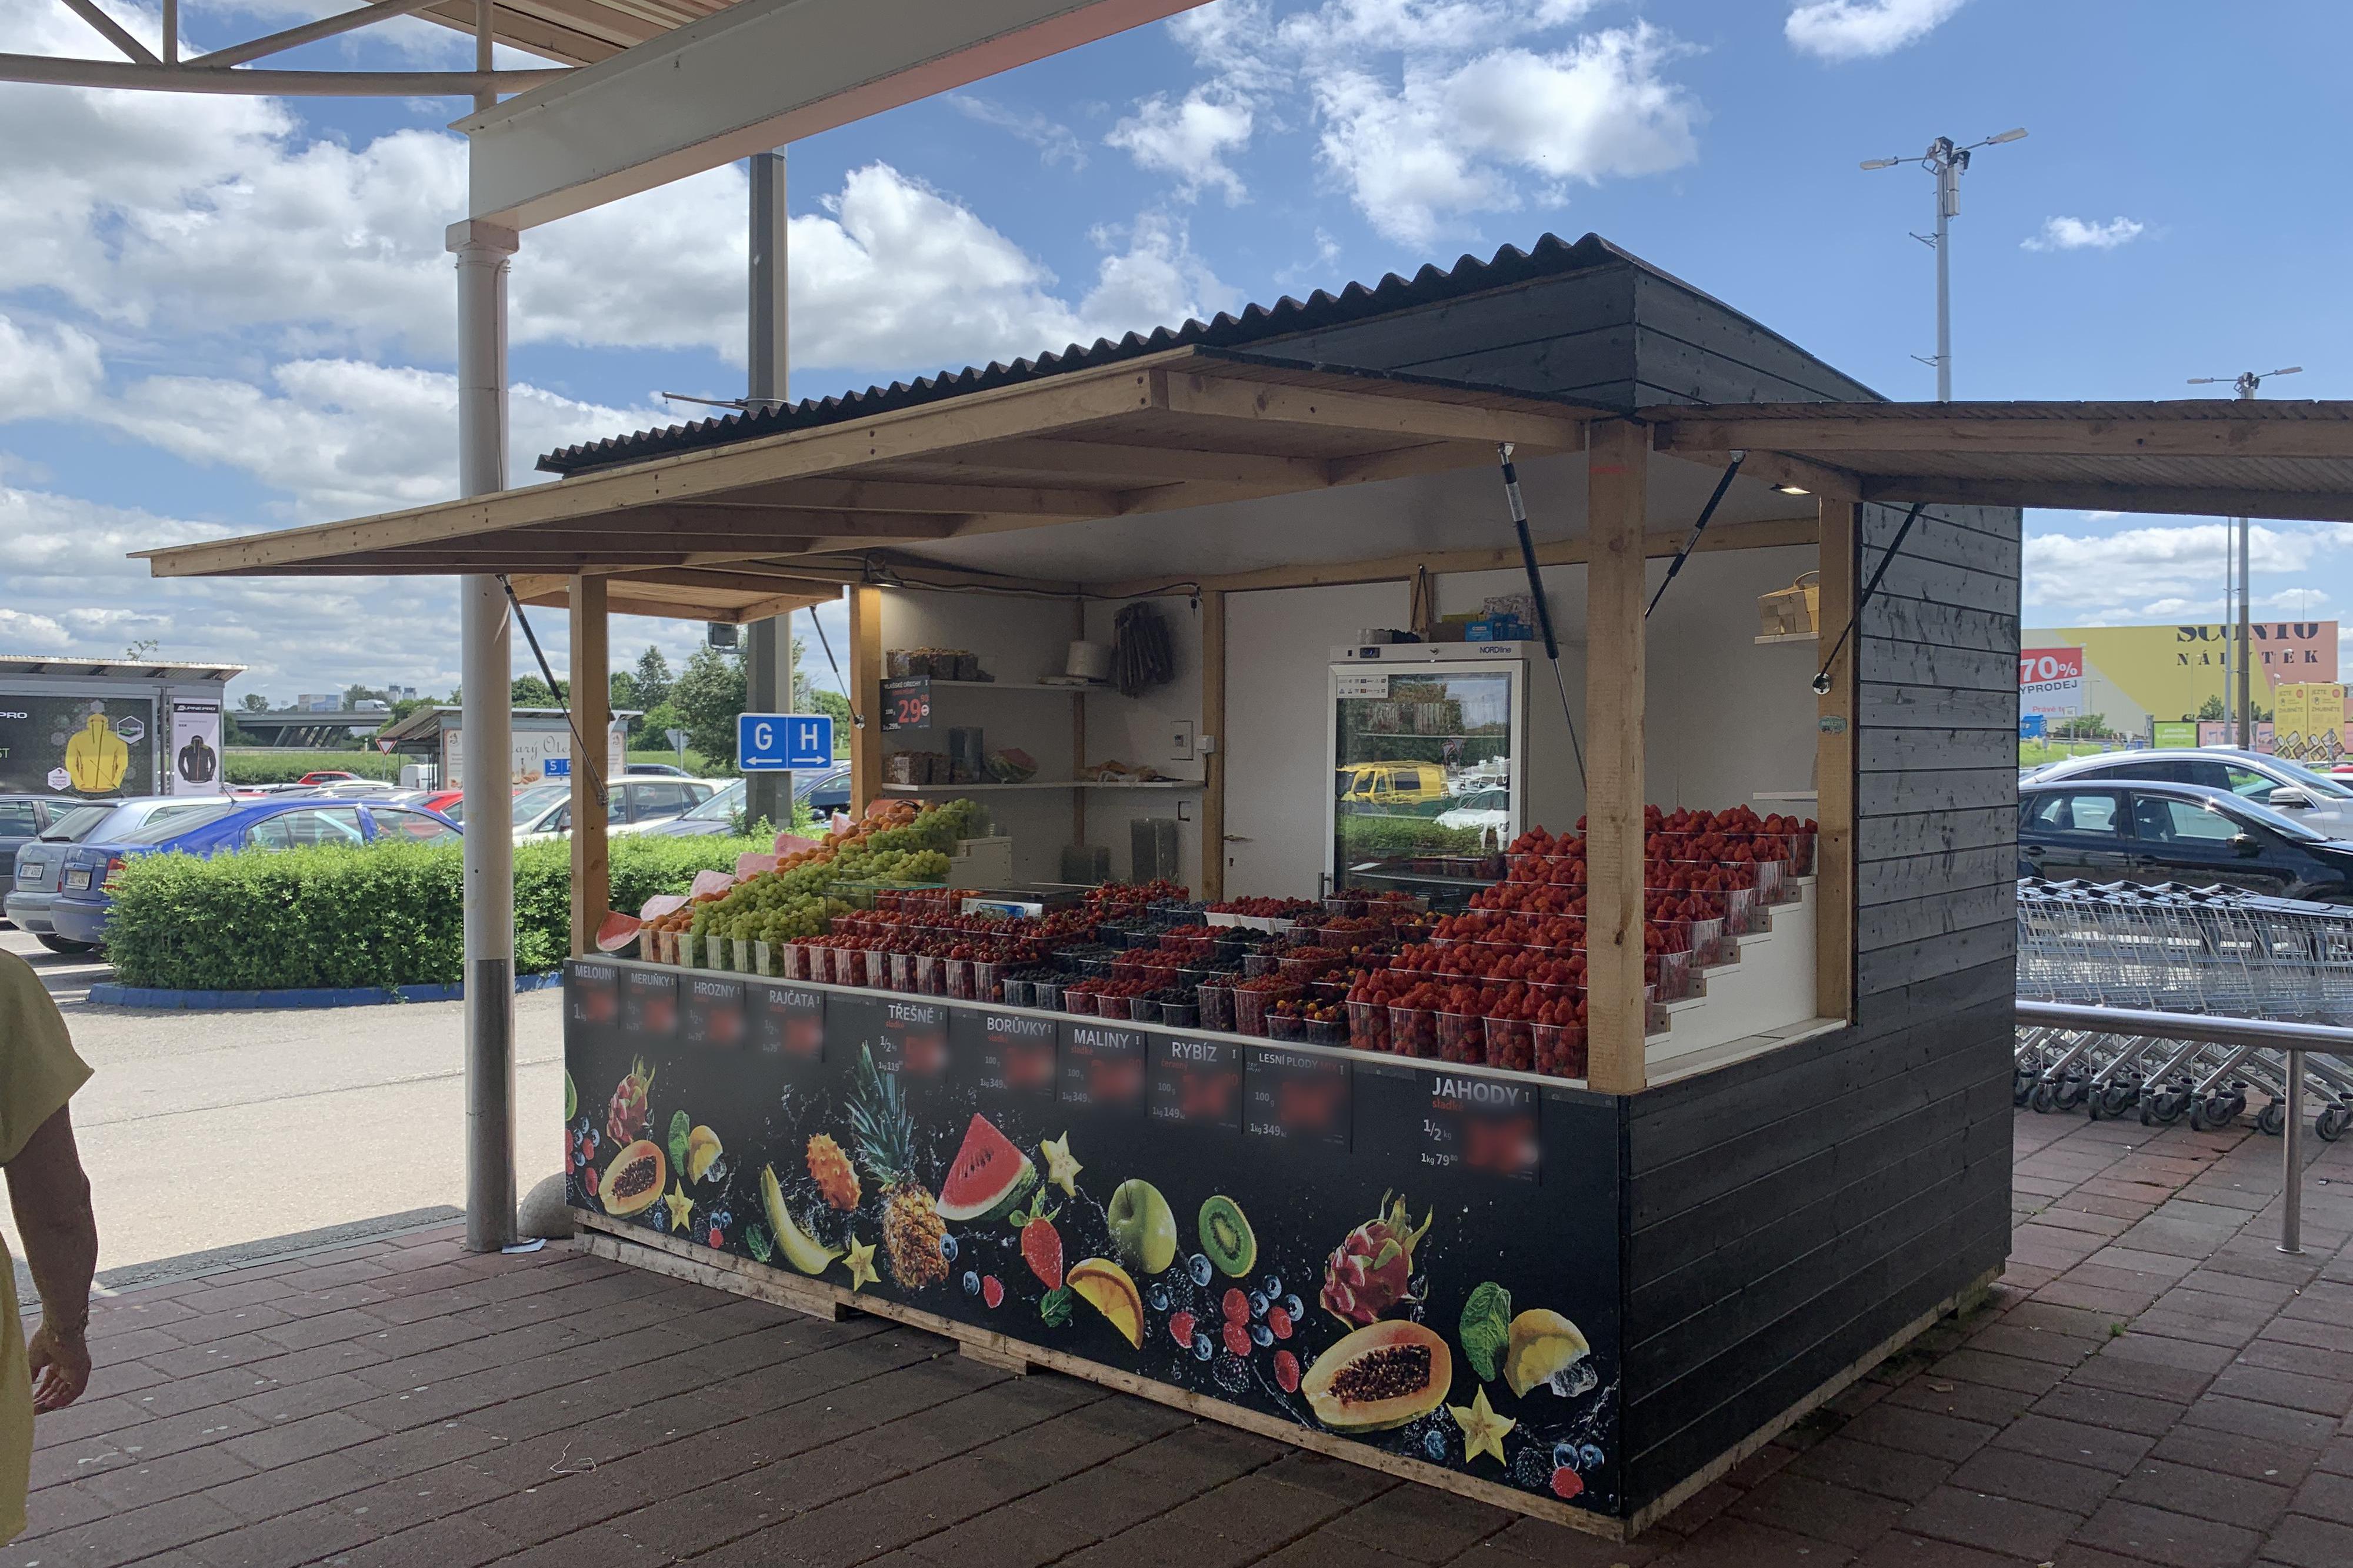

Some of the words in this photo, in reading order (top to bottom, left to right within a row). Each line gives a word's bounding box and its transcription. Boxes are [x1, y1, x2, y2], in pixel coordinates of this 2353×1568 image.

[898, 698, 922, 723] 29
[755, 722, 772, 750] G
[801, 723, 818, 750] H
[550, 760, 557, 770] S
[575, 965, 612, 980] MELOUN
[631, 972, 669, 986] MERUŇKY
[694, 981, 735, 997] HROZNY
[769, 989, 815, 1008] RAJČATA
[888, 1003, 934, 1024] TŘEŠNĚ
[987, 1016, 1046, 1036] BORŮVKY
[880, 1035, 891, 1052] 1/2
[1074, 1029, 1129, 1049] MALINY
[985, 1056, 996, 1065] 100
[1172, 1042, 1217, 1063] RYBÍZ
[1259, 1053, 1285, 1065] LESNÍ
[1287, 1056, 1318, 1070] PLODY
[1320, 1061, 1338, 1072] MIX
[1068, 1068, 1080, 1077] 100
[1158, 1082, 1171, 1092] 100
[1432, 1077, 1519, 1106] JAHODY
[1072, 1092, 1088, 1103] 349
[1255, 1092, 1269, 1102] 100
[1270, 1100, 1275, 1108] g
[1432, 1097, 1464, 1112] sladké
[1164, 1106, 1179, 1119] 149
[1262, 1123, 1280, 1136] 349
[1424, 1119, 1442, 1142] 1/2
[1443, 1130, 1451, 1141] kg
